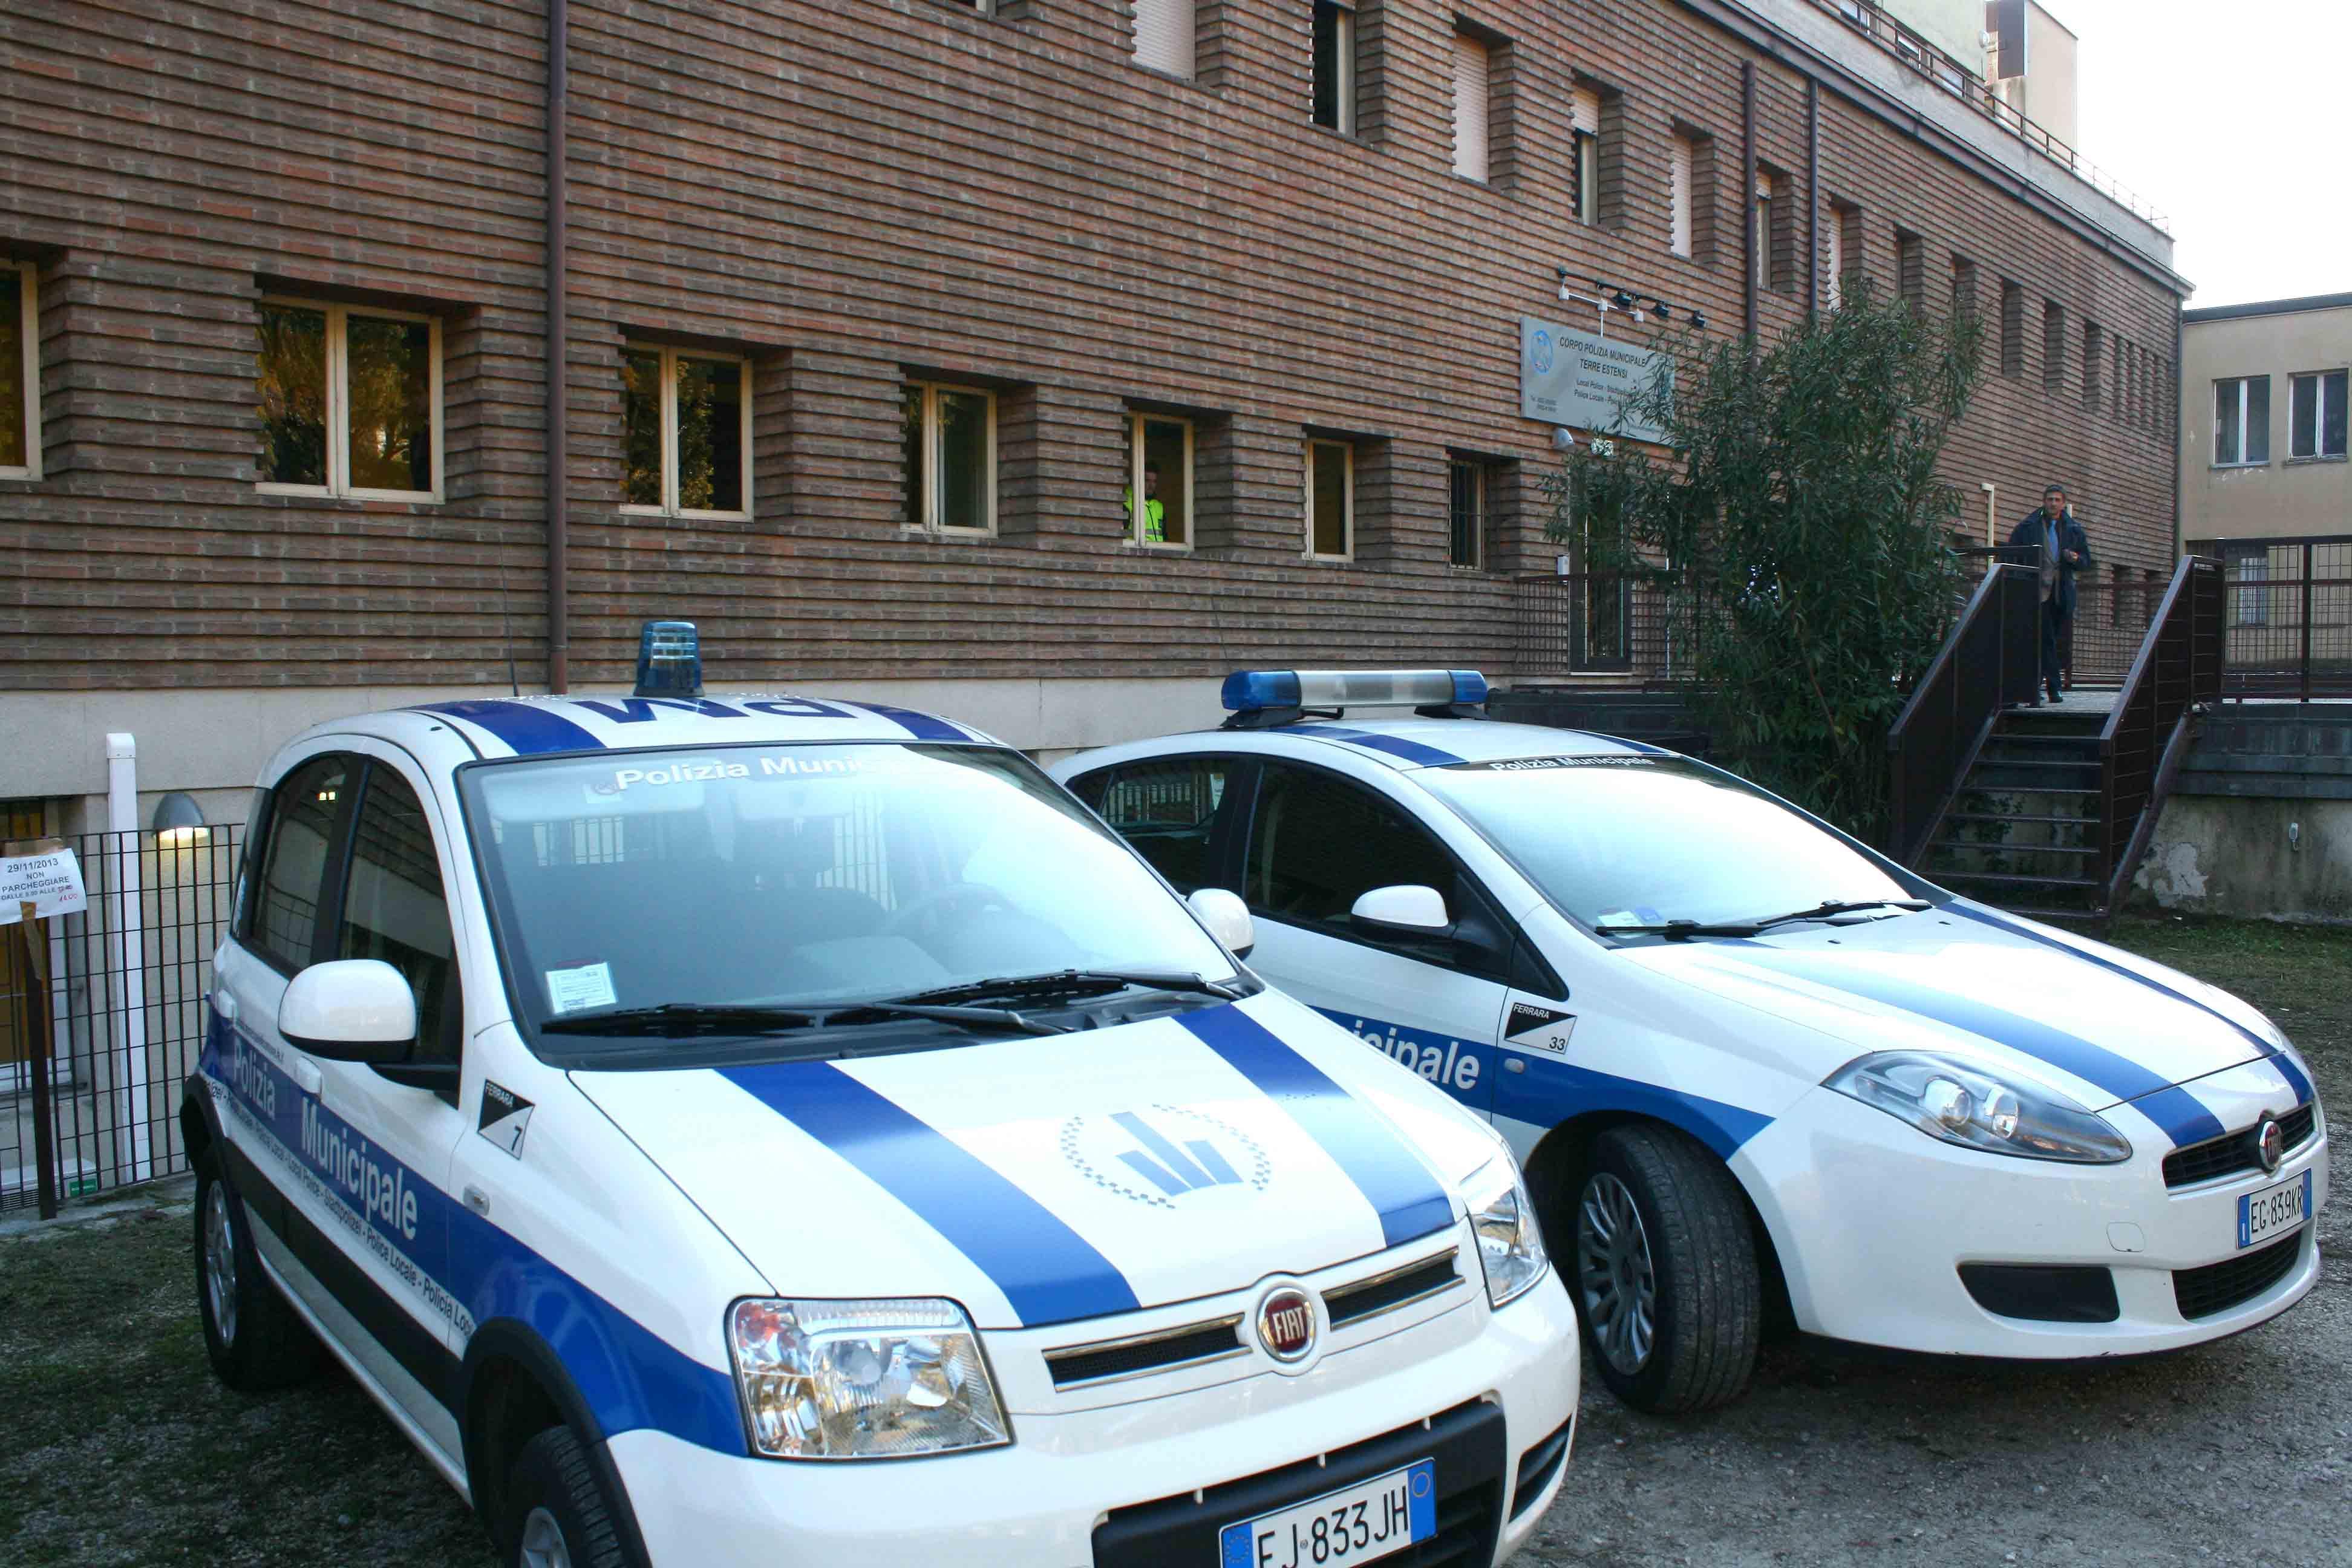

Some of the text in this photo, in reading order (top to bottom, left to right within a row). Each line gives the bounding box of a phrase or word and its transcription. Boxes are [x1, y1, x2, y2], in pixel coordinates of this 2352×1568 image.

[1560, 337, 1645, 365] CORPO POLIZIA MUNICIPALE
[1580, 358, 1627, 378] TERRE ESTENSI
[615, 754, 862, 789] Polizia Muni
[1489, 757, 1655, 770] Polizia Municipale
[7, 858, 59, 873] 29/11/2013
[26, 871, 44, 880] NON
[1, 892, 24, 901] DALLE
[2, 876, 70, 893] PARCHEGGIARE
[1513, 1004, 1549, 1019] FERRARA
[1353, 1019, 1480, 1089] ipale
[1549, 1037, 1566, 1051] 33
[485, 1081, 514, 1108] FERRARA
[234, 1034, 275, 1121] Polizia
[302, 1096, 417, 1241] Municipale
[511, 1125, 522, 1151] 7
[2251, 1184, 2304, 1234] EG 839KR
[390, 1247, 417, 1287] Locale
[1272, 1306, 1305, 1345] FIAT
[1312, 1485, 1409, 1564] 833JH
